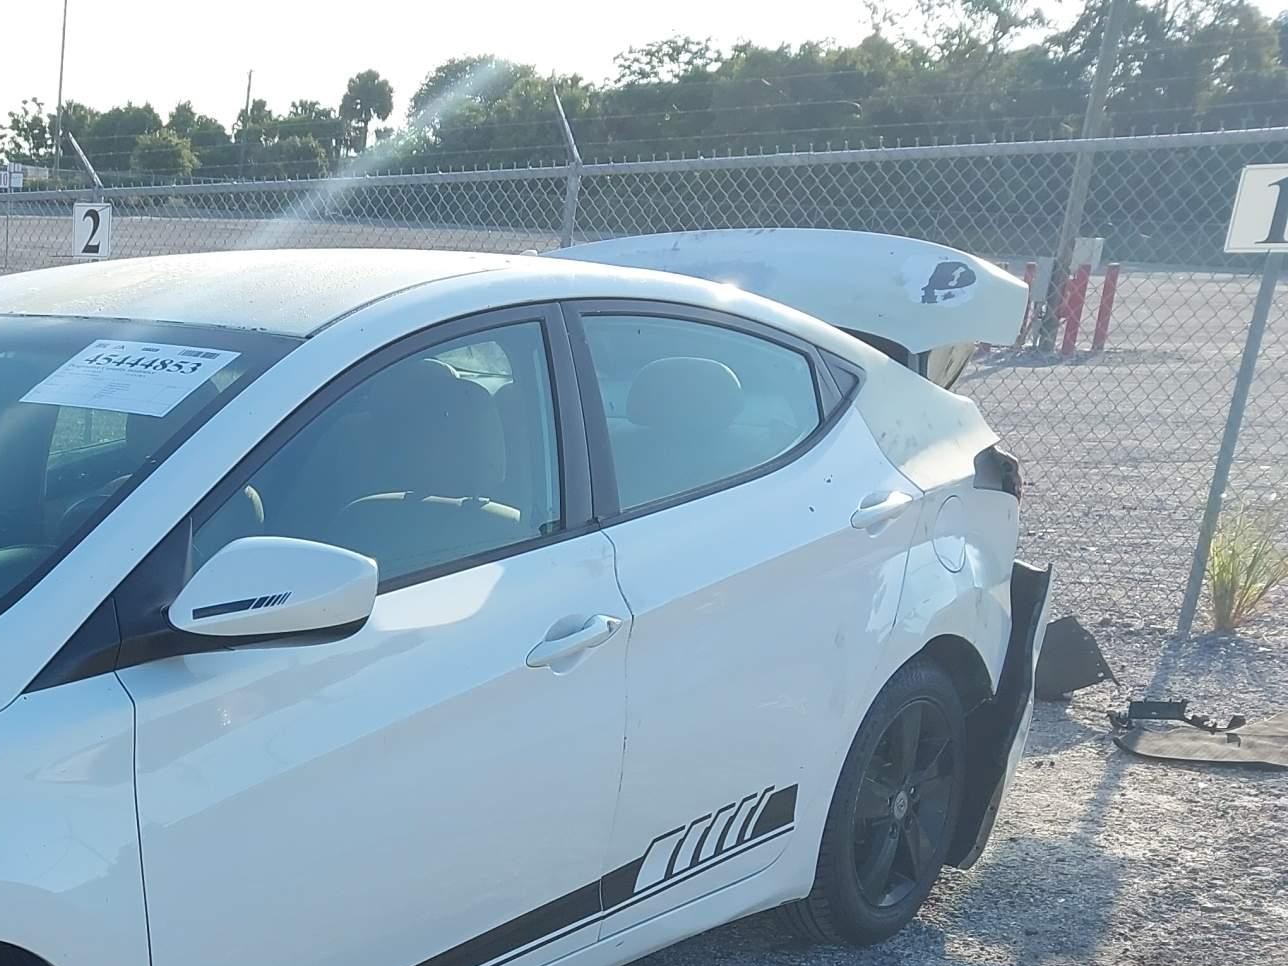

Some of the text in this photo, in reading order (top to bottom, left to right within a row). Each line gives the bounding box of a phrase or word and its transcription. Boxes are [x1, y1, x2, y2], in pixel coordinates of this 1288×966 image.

[81, 208, 101, 254] 2
[1253, 176, 1288, 245] 1
[84, 352, 203, 375] 45444853
